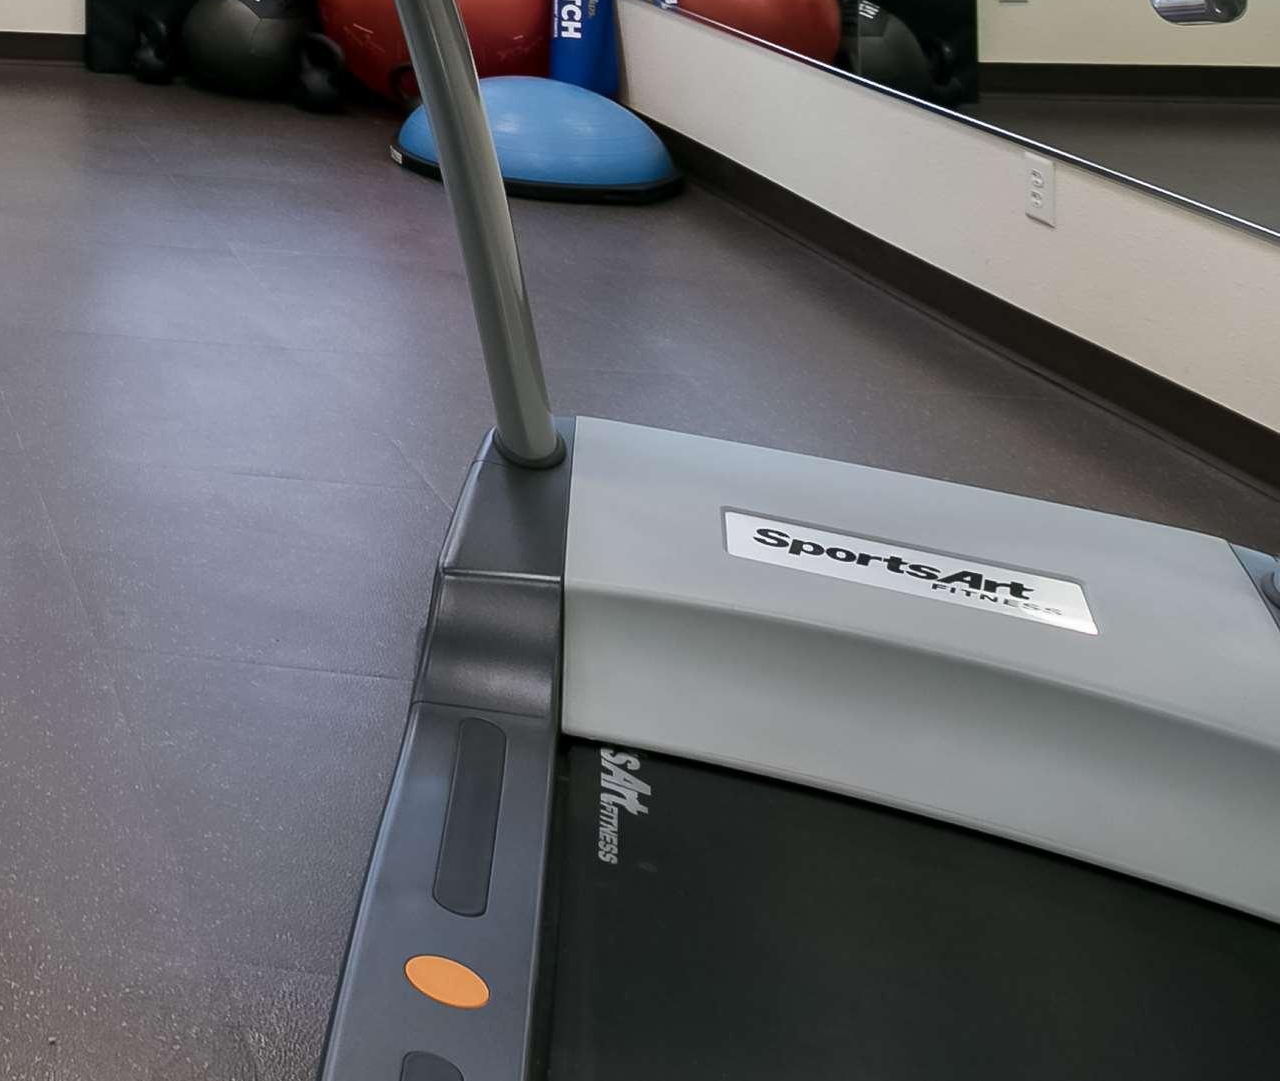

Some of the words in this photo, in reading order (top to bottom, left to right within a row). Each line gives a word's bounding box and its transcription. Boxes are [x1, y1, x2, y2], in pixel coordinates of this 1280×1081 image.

[753, 527, 1034, 600] SportsArt
[931, 583, 1063, 616] FITNESS
[598, 800, 618, 865] FITNESS
